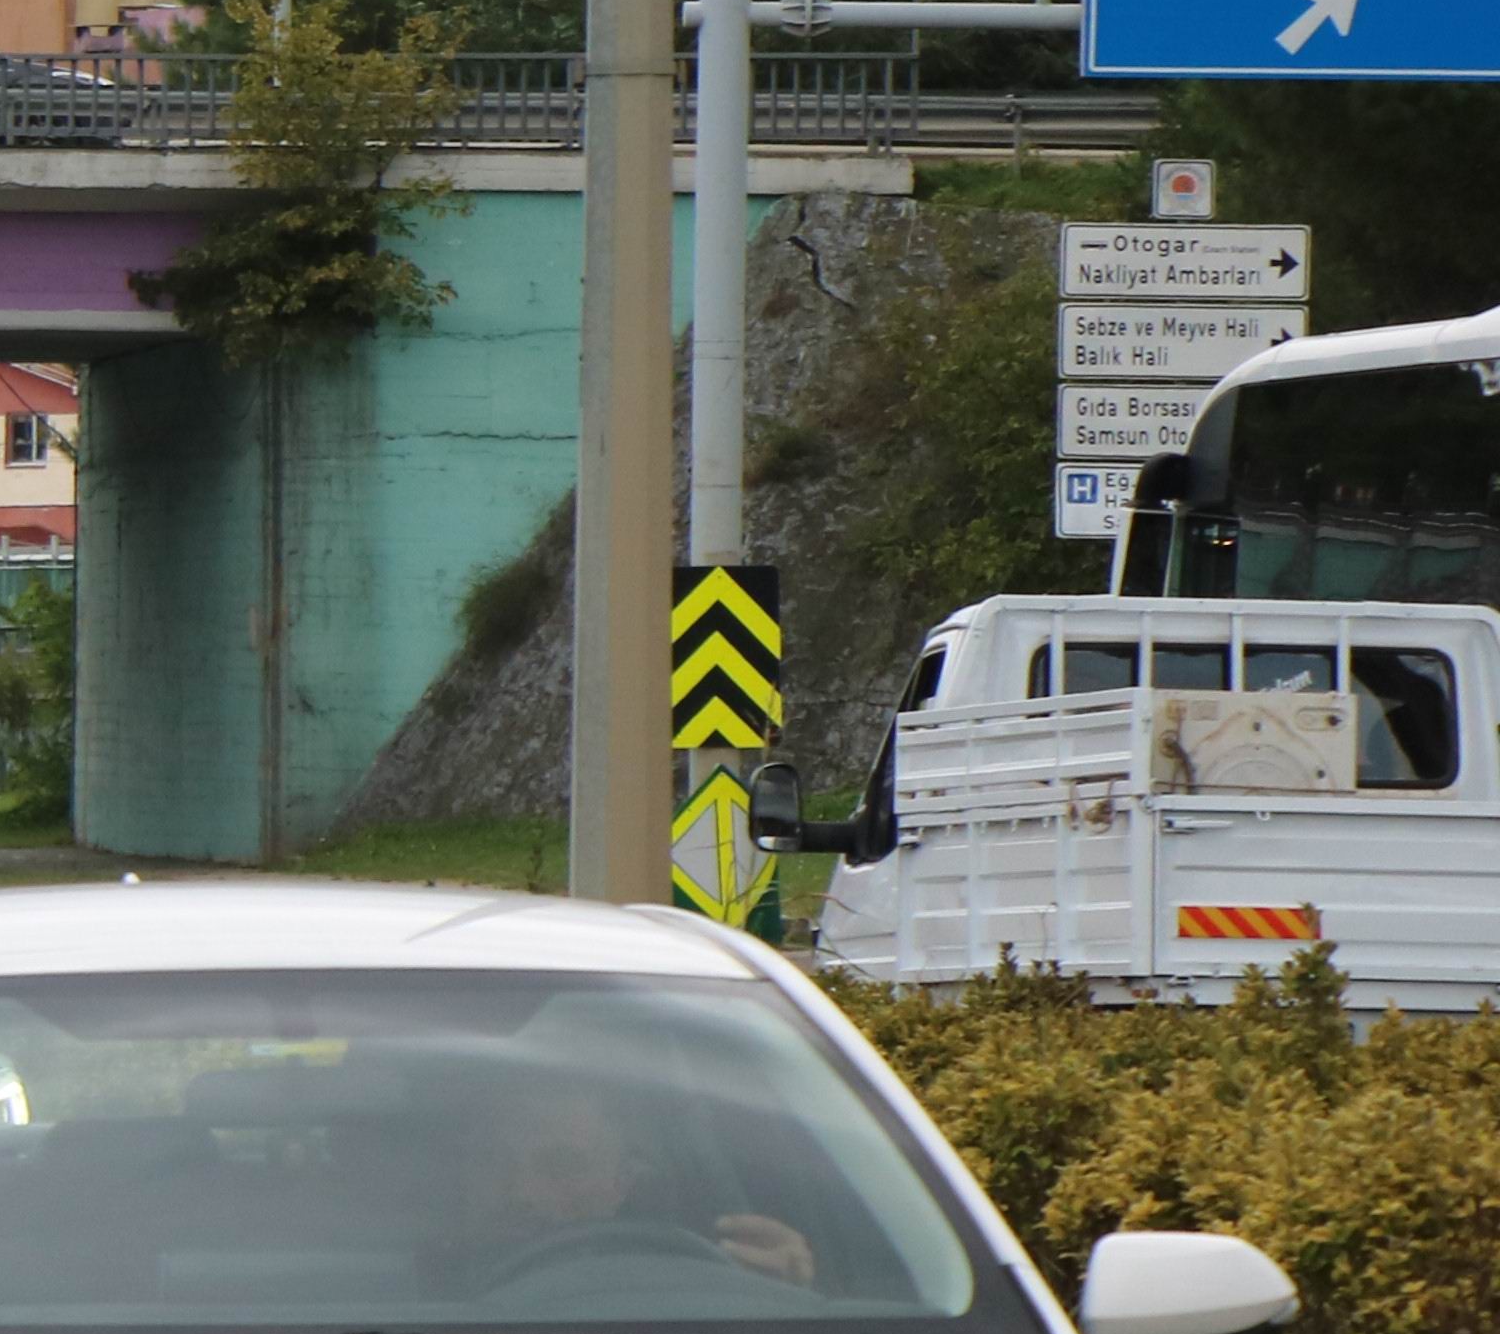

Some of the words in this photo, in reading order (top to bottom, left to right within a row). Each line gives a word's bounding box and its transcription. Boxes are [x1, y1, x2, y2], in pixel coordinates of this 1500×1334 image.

[1113, 234, 1200, 257] Otogar
[1078, 264, 1157, 289] Nakliyat
[1164, 264, 1261, 286] Ambarları
[1075, 317, 1127, 336] Sebze
[1135, 322, 1154, 336] ve
[1162, 318, 1217, 346] Meyve
[1225, 319, 1259, 338] Hali
[1075, 345, 1122, 365] Balık
[1131, 346, 1168, 366] Hali
[1077, 397, 1117, 417] Gıda
[1128, 397, 1196, 417] Borsası
[1076, 425, 1149, 445] Samsun
[1158, 426, 1188, 445] Oto
